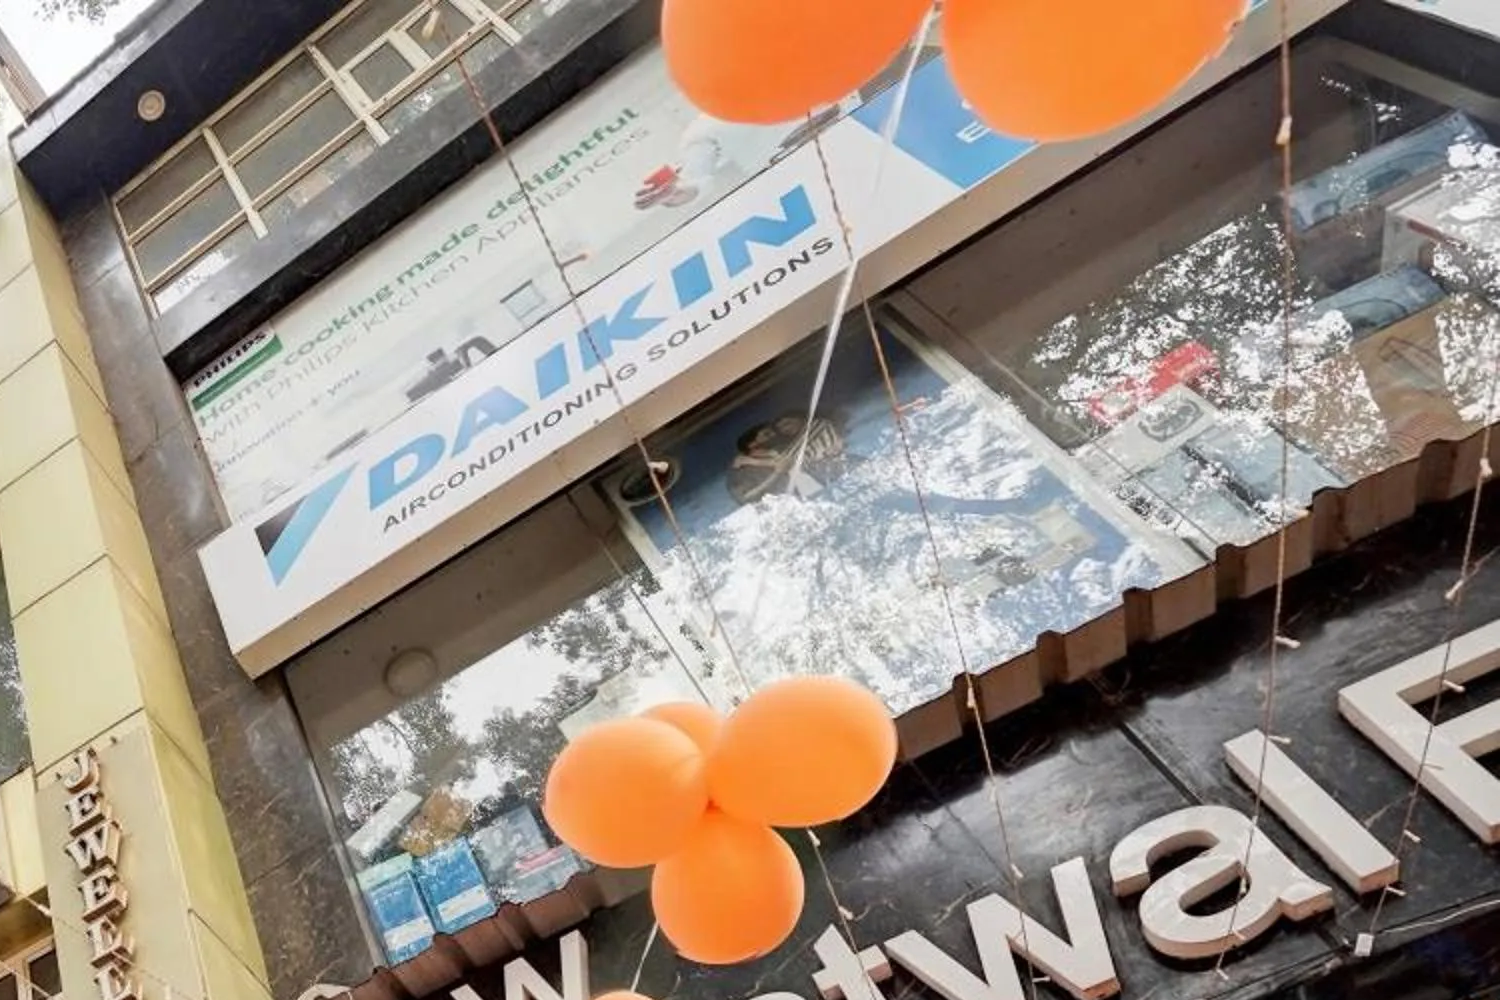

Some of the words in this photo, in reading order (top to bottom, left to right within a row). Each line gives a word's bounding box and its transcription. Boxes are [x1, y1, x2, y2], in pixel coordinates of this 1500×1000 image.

[193, 331, 267, 388] PHILIPS
[199, 366, 278, 427] Home
[283, 284, 394, 366] cooking
[396, 223, 479, 286] made
[486, 107, 640, 220] delightful
[206, 402, 262, 444] with
[266, 335, 358, 400] Philips
[362, 254, 470, 334] Kitchen
[477, 128, 650, 254] Appliances
[368, 184, 818, 512] DAIKIN
[382, 361, 638, 532] AIRCONDITIONING
[646, 235, 836, 363] SOLUTIONS
